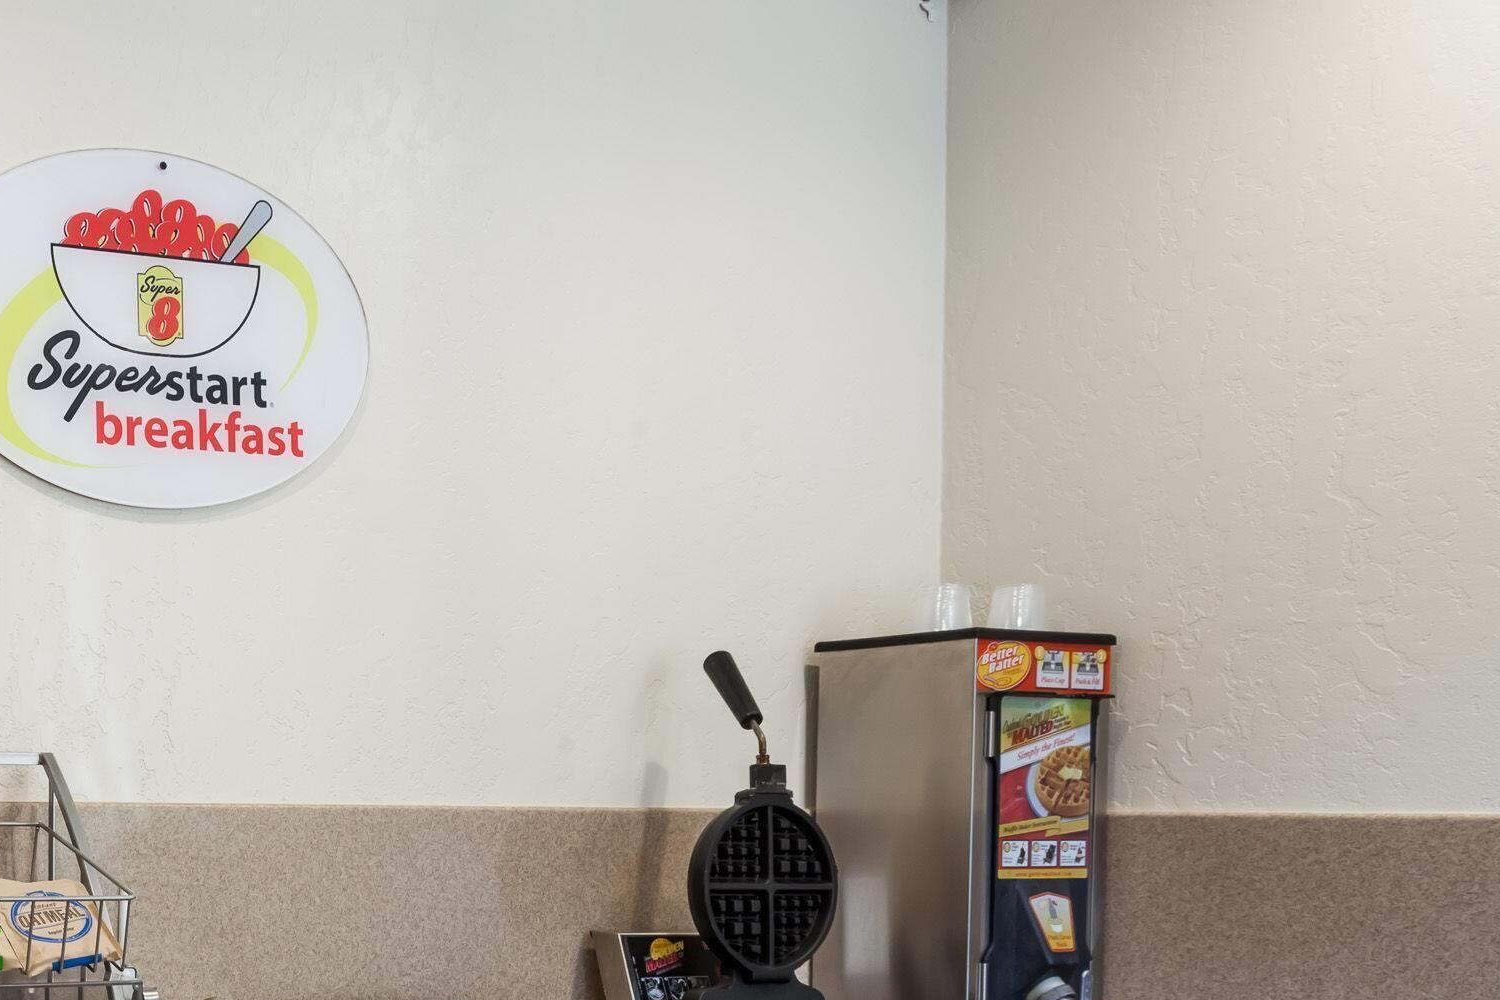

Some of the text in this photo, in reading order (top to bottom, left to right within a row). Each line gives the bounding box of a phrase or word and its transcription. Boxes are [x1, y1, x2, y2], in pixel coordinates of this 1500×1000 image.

[140, 275, 181, 302] Super
[146, 296, 181, 341] 8
[27, 329, 268, 422] Superstart
[95, 400, 304, 457] breakfast
[982, 646, 1018, 665] Better
[988, 655, 1024, 673] Batter
[1011, 719, 1054, 746] MALTED
[1018, 746, 1041, 760] Simply
[1041, 741, 1052, 753] the
[18, 905, 86, 928] OATMEAL
